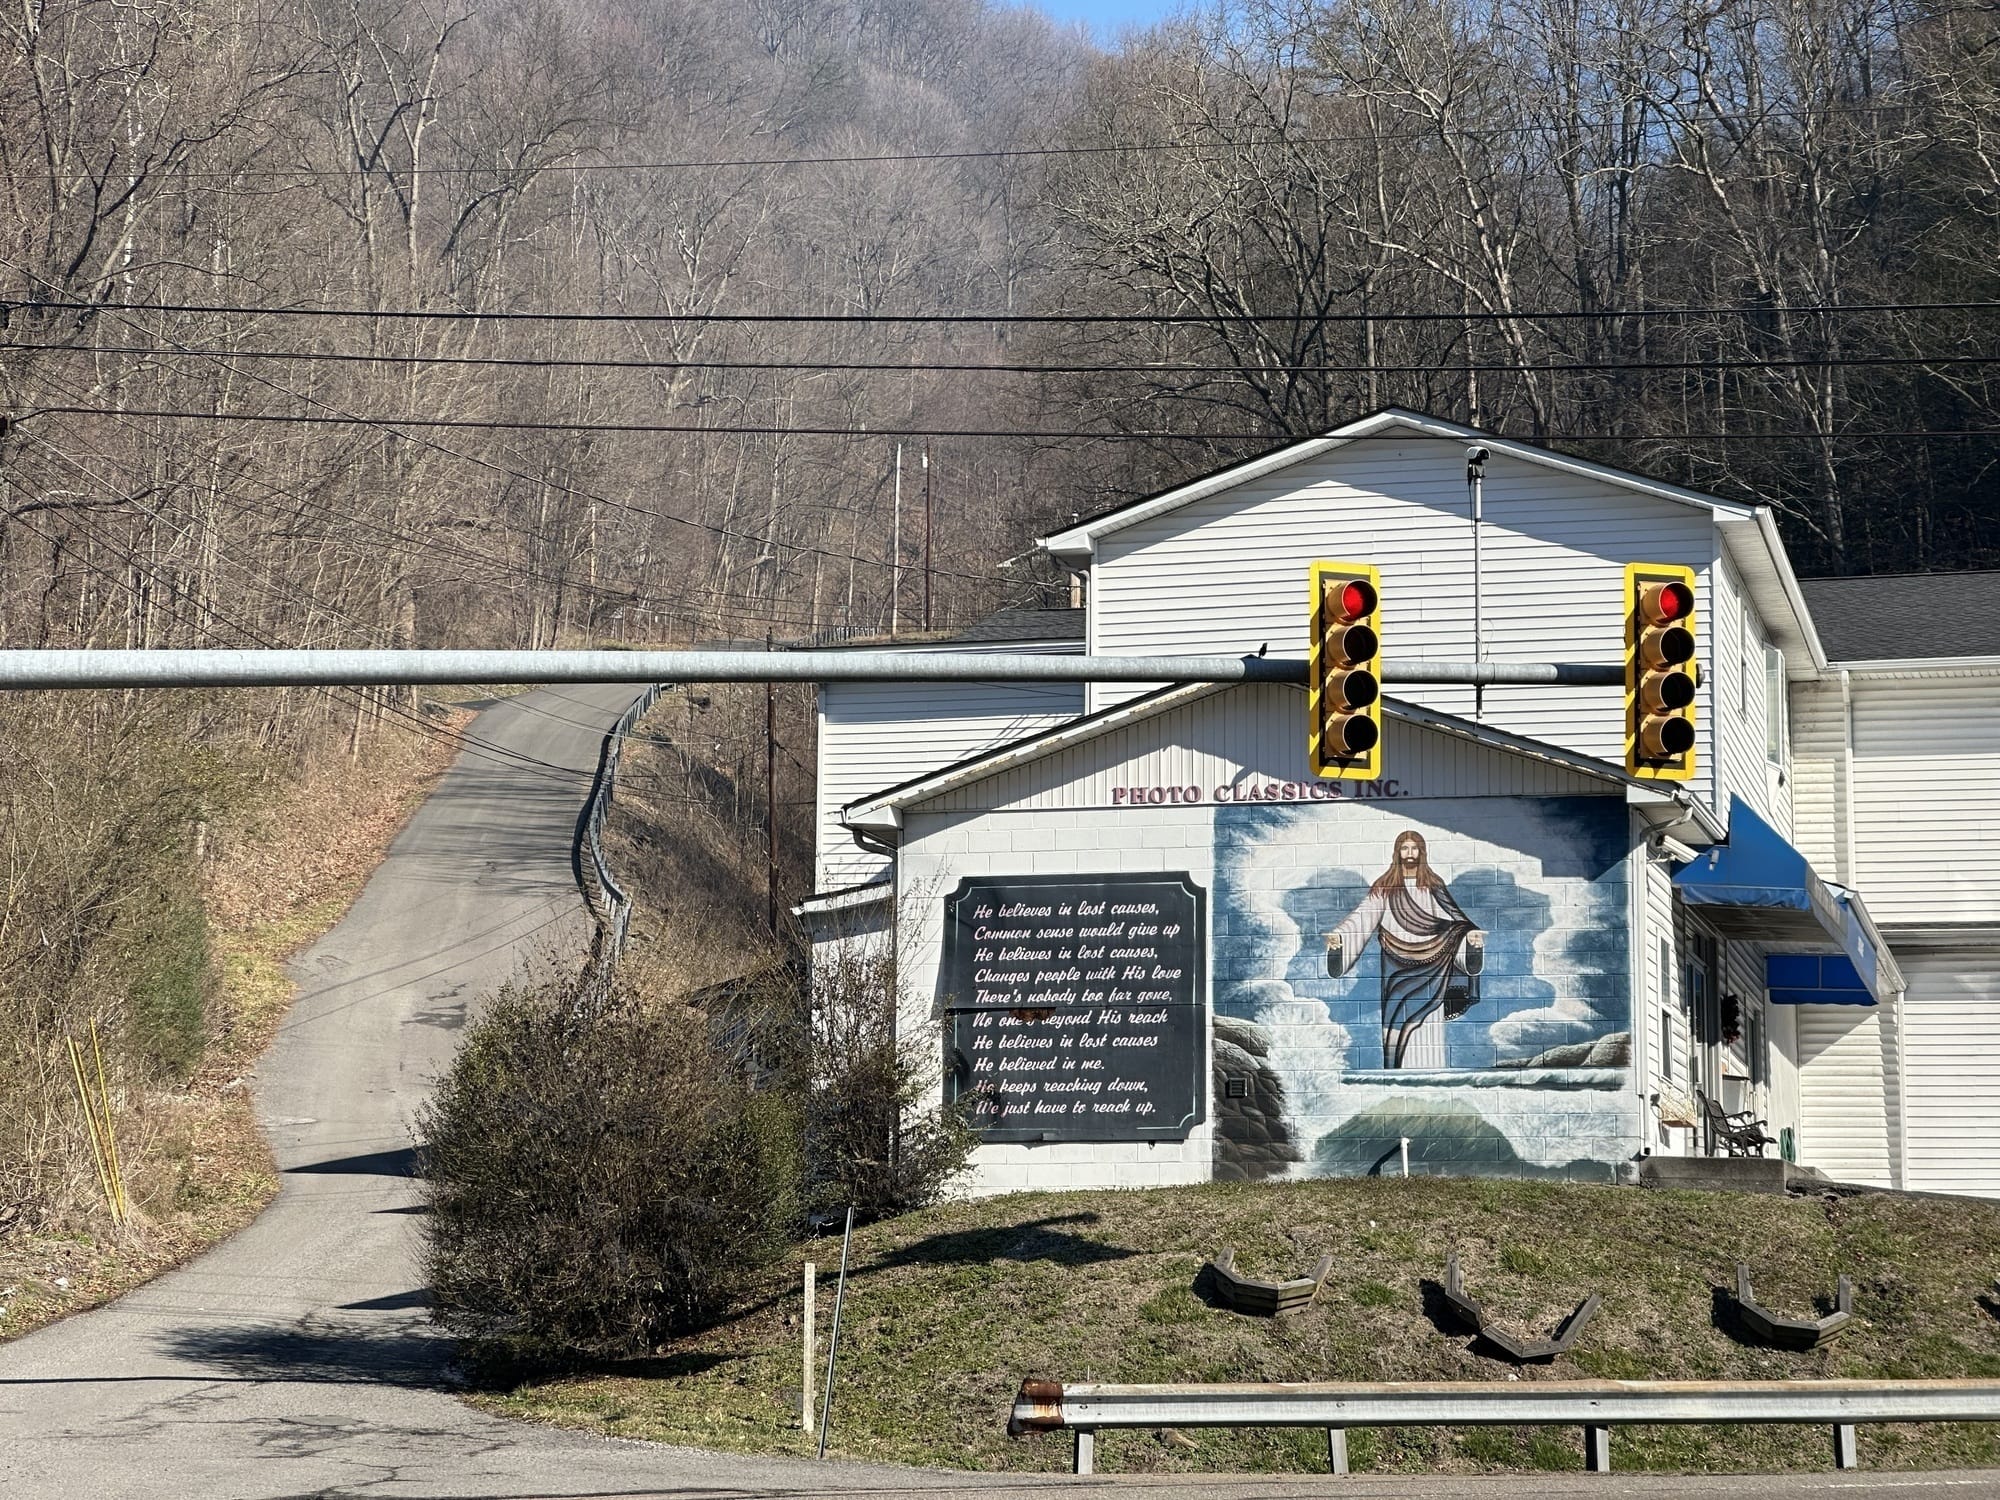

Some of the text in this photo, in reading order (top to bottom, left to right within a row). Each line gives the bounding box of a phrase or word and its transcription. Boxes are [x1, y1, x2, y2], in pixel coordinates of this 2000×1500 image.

[1112, 780, 1408, 804] PHOTO CLASSICS INC.
[973, 901, 1159, 919] He believes in lost causes,
[974, 922, 1180, 940] Common sense would give up
[974, 948, 993, 962] He
[999, 947, 1051, 960] believes
[1058, 947, 1071, 959] in
[1078, 945, 1105, 959] lost
[975, 965, 1181, 984] Changes people with His love
[976, 987, 1172, 1004] There's nobody too far gone,
[973, 1012, 992, 1028] No
[1097, 1010, 1121, 1024] His
[1128, 1009, 1168, 1023] reach
[972, 1033, 1159, 1050] He believes in lost causes
[973, 1056, 1104, 1071] He believed in me.
[1000, 1079, 1036, 1096] keeps
[1043, 1078, 1102, 1094] reaching
[1108, 1077, 1148, 1093] down,
[976, 1099, 1156, 1117] We just have to reach up.
